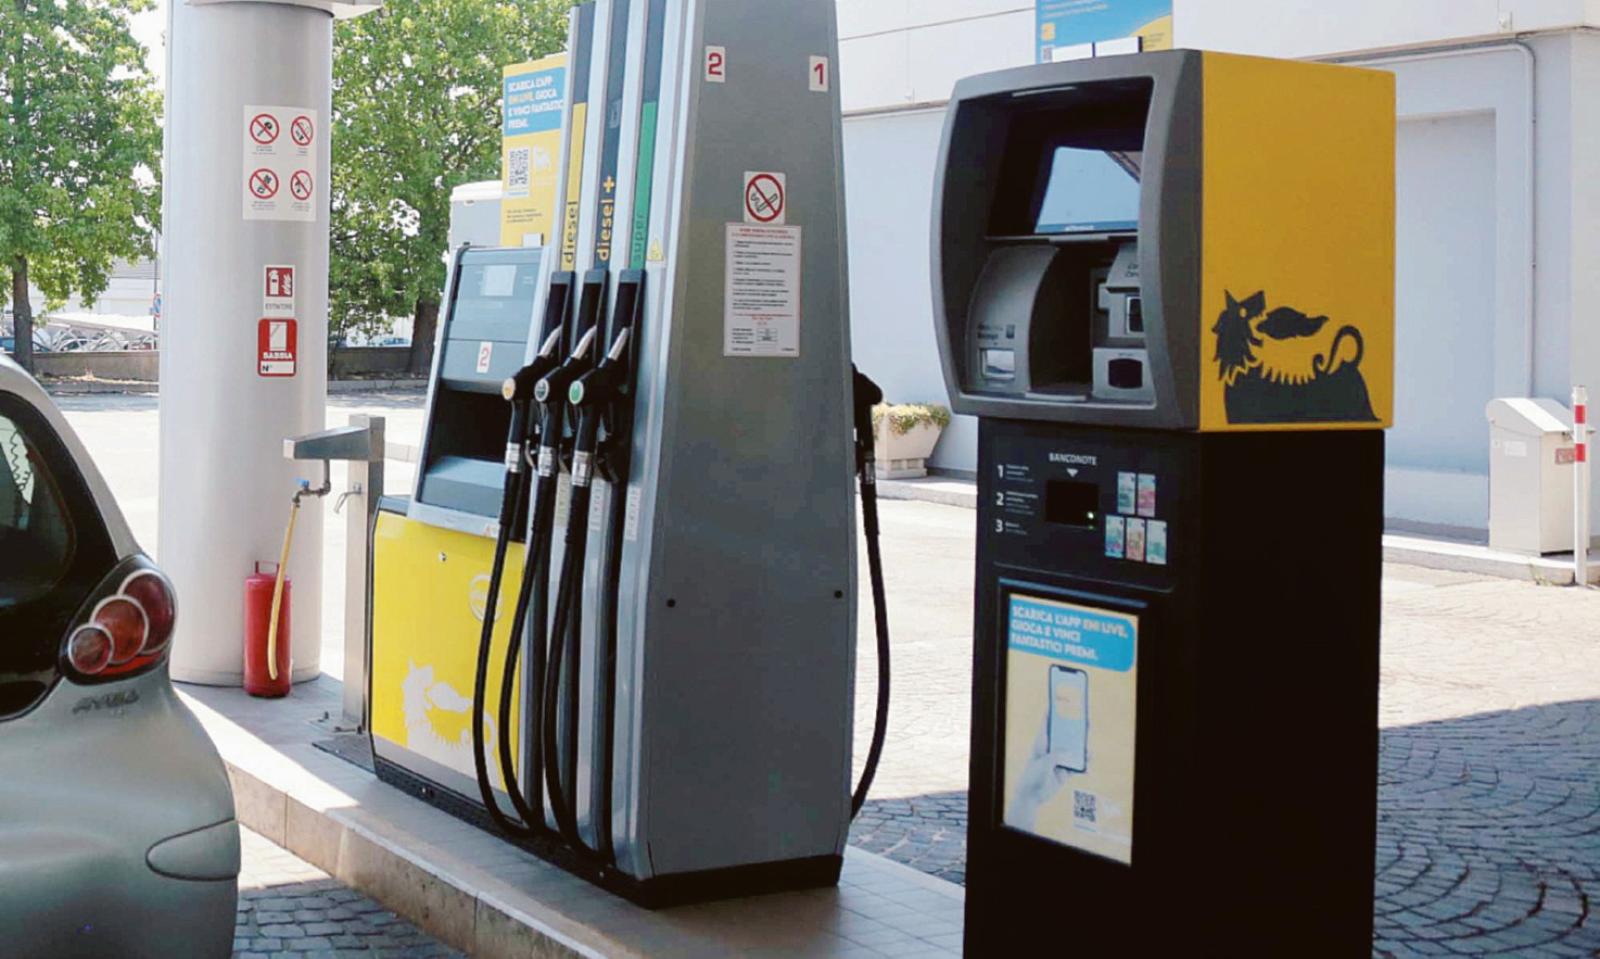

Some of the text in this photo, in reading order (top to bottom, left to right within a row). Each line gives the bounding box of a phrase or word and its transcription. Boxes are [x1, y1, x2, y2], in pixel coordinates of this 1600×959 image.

[708, 52, 722, 76] 2
[814, 63, 824, 85] 1
[563, 200, 578, 263] diesel
[596, 199, 614, 261] diesel
[632, 214, 644, 263] super
[479, 347, 490, 367] 2
[1048, 452, 1098, 466] BANCONOTE
[996, 464, 1004, 479] 1
[996, 492, 1004, 506] 2
[995, 519, 1004, 533] 3
[1012, 605, 1053, 624] SCARICA
[1083, 618, 1099, 631] ENI
[1011, 619, 1081, 642] GIOCA E VINCI
[1011, 632, 1098, 661] FANTASTICI PREMI.
